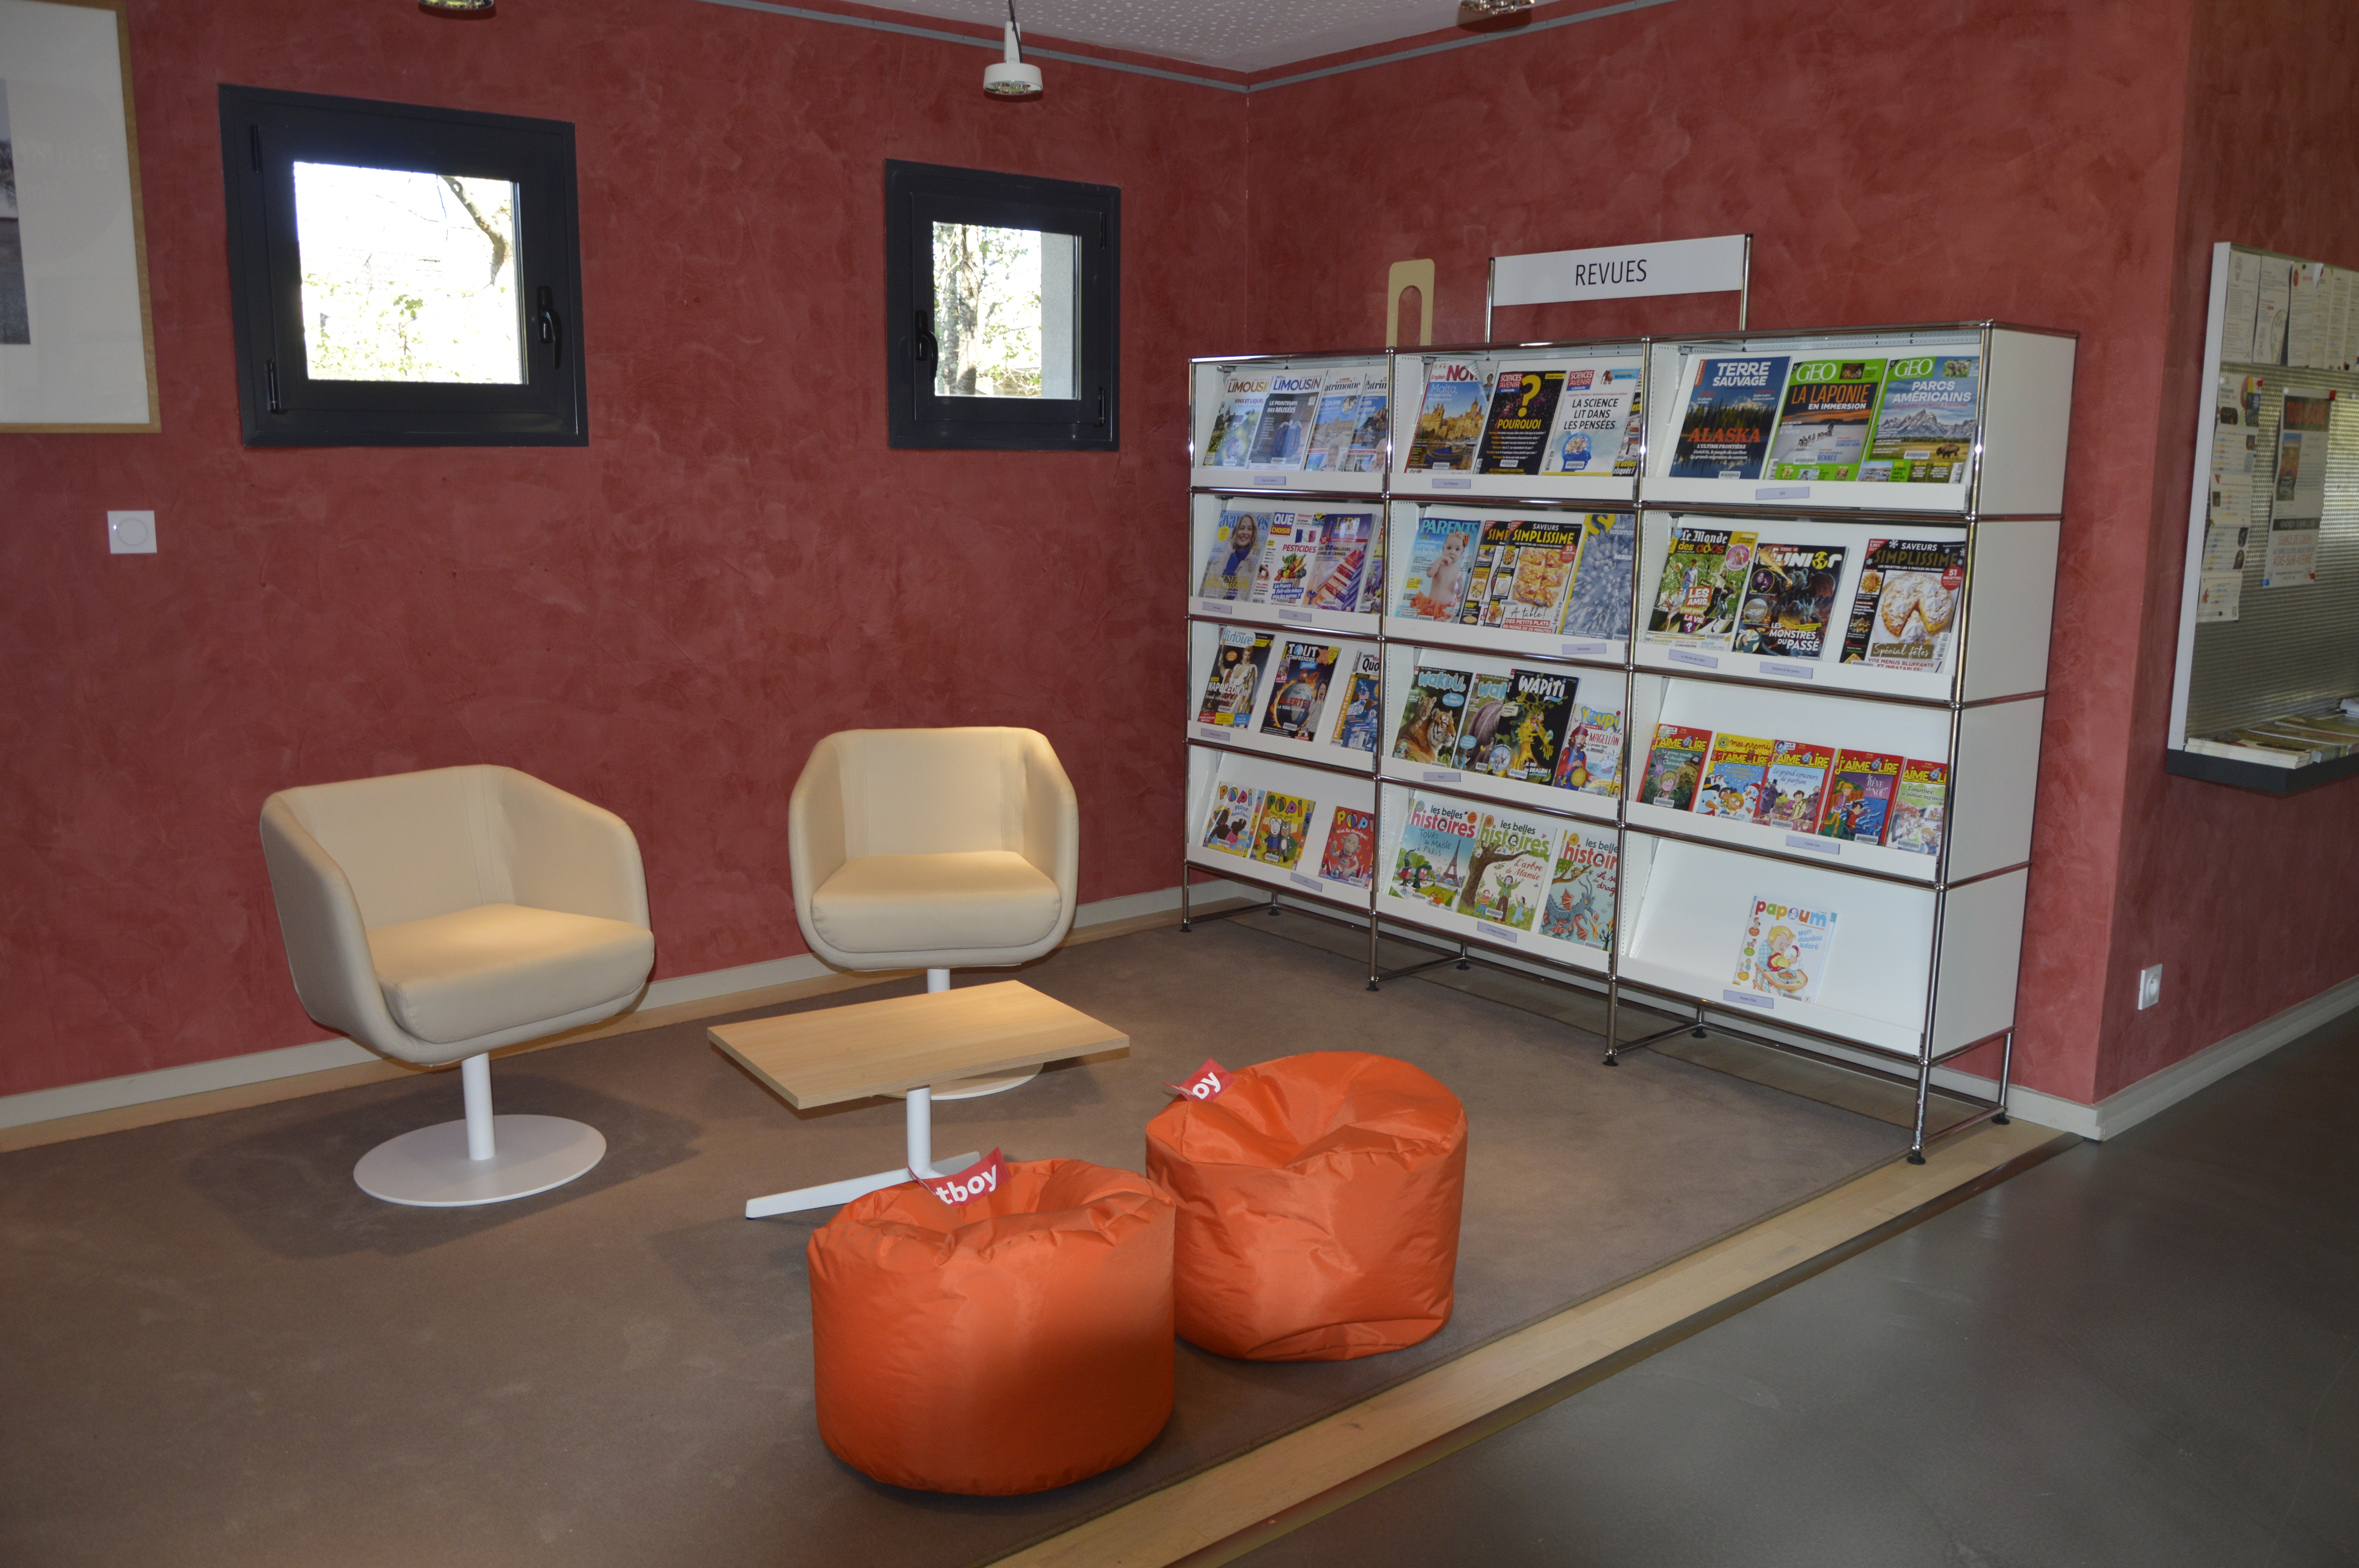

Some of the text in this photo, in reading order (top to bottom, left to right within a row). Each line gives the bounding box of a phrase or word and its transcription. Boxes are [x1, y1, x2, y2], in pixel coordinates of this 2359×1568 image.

[1575, 259, 1647, 286] REVUES
[1717, 362, 1771, 376] TERRE
[1796, 363, 1836, 381] GEO
[1894, 359, 1933, 377] GEO
[1712, 376, 1768, 387] SAUVAGE
[1912, 381, 1956, 391] PARCS
[1432, 384, 1457, 394] Malta,
[1792, 384, 1871, 404] LA LAPONIE
[1572, 399, 1619, 408] LA SCIENCE
[1892, 391, 1972, 403] AMÉRICAINS
[1574, 410, 1611, 418] LIT DANS
[1497, 419, 1541, 429] POURQUOI
[1564, 421, 1578, 430] LES
[1687, 428, 1761, 443] ALASKA
[1613, 467, 1632, 475] risqués
[1274, 513, 1294, 525] QUE
[1420, 520, 1479, 535] PARENTS
[1512, 530, 1575, 544] SIMPLISSIME
[1680, 530, 1728, 544] Le Monde
[1283, 544, 1316, 553] PESTICIDES
[1678, 541, 1725, 554] des ados
[1901, 543, 1937, 551] SAVEURS
[1874, 550, 1958, 567] SIMPLISSIME
[1689, 588, 1710, 598] LES
[1511, 607, 1519, 618] A
[1686, 622, 1692, 632] ?
[1222, 630, 1253, 644] Histoire
[1769, 630, 1816, 640] MONSTRES
[1289, 644, 1318, 657] TOUT
[1786, 638, 1819, 651] PASSÉ
[1874, 643, 1931, 660] Spécial fêtes
[1353, 652, 1363, 672] Quotidien
[1279, 696, 1312, 713] ALERTE !
[1334, 710, 1345, 738] Planètes
[1346, 677, 1354, 701] espace
[1589, 733, 1619, 746] MAGELLAN
[1688, 737, 1708, 750] LIRE
[1808, 753, 1830, 767] LIRE
[1878, 759, 1899, 774] LIRE
[1867, 777, 1885, 788] RÊVE
[1908, 786, 1934, 795] Timothée
[1430, 805, 1463, 819] les belles
[1411, 808, 1476, 838] histoires
[1500, 820, 1536, 835] les belles
[1419, 829, 1438, 839] TOURS
[1480, 822, 1549, 855] histoires
[1431, 841, 1451, 849] MAGIE
[1586, 838, 1597, 848] les
[1514, 858, 1543, 871] L'arbre
[1513, 868, 1541, 880] Mamie
[1597, 871, 1607, 880] Le
[1755, 901, 1827, 927] papoum
